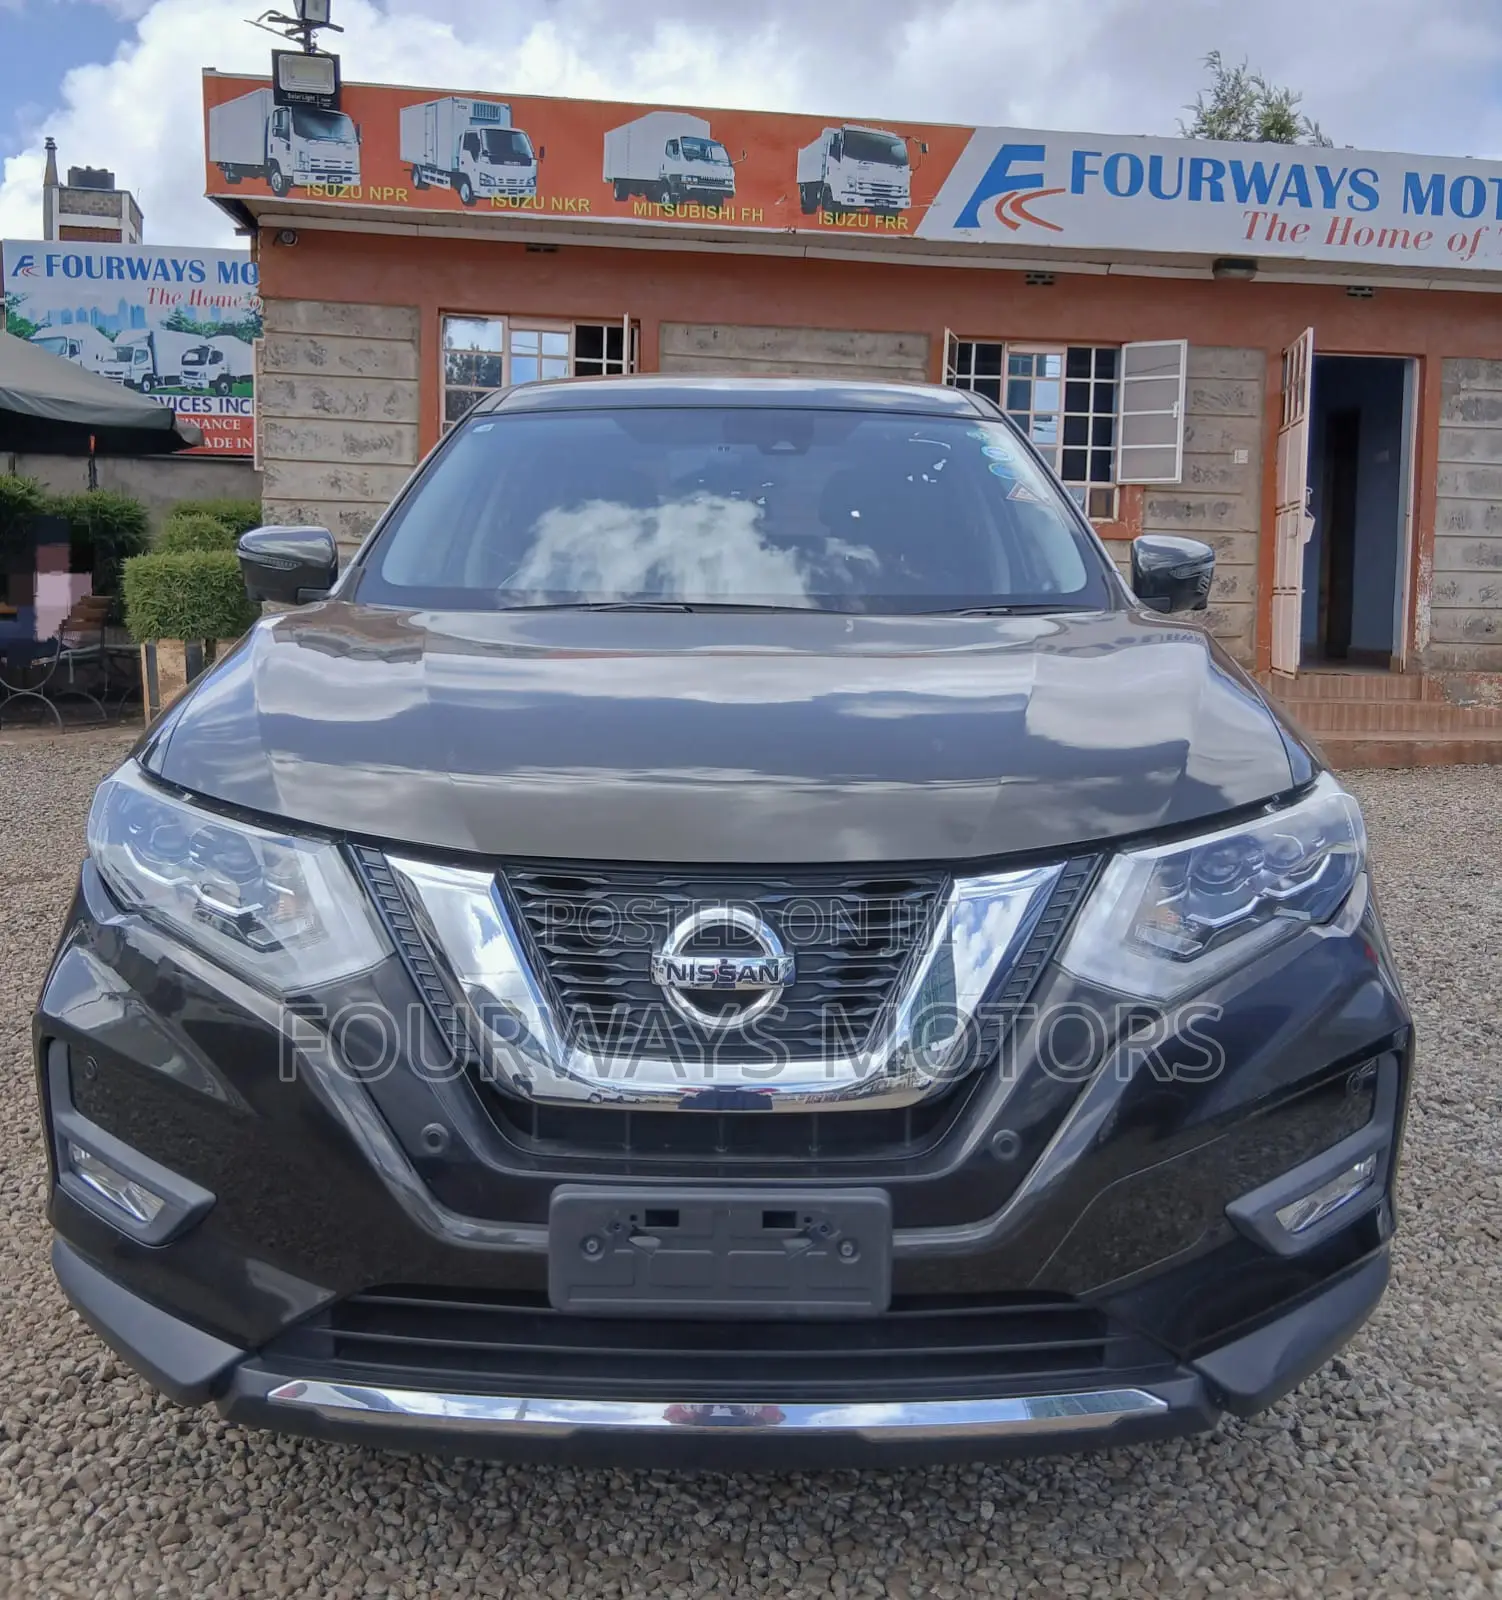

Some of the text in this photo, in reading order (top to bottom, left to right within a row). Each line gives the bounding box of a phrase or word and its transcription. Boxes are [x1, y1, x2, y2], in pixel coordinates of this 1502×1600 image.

[1071, 150, 1380, 212] FOURWAYS
[306, 184, 408, 202] ISUZU NPR
[491, 196, 591, 212] ISUZU NKR
[633, 201, 764, 222] MITSUBISHI FH
[818, 211, 909, 230] ISUZU FRR
[1242, 210, 1311, 243] The
[1323, 216, 1434, 251] Home
[1447, 225, 1490, 261] of
[46, 254, 206, 283] FOURWAYS
[147, 287, 182, 305] The
[189, 289, 242, 308] Home
[148, 395, 254, 414] VICES INC
[180, 418, 240, 430] NANCE
[238, 438, 252, 448] IN
[666, 962, 780, 984] NISSAN
